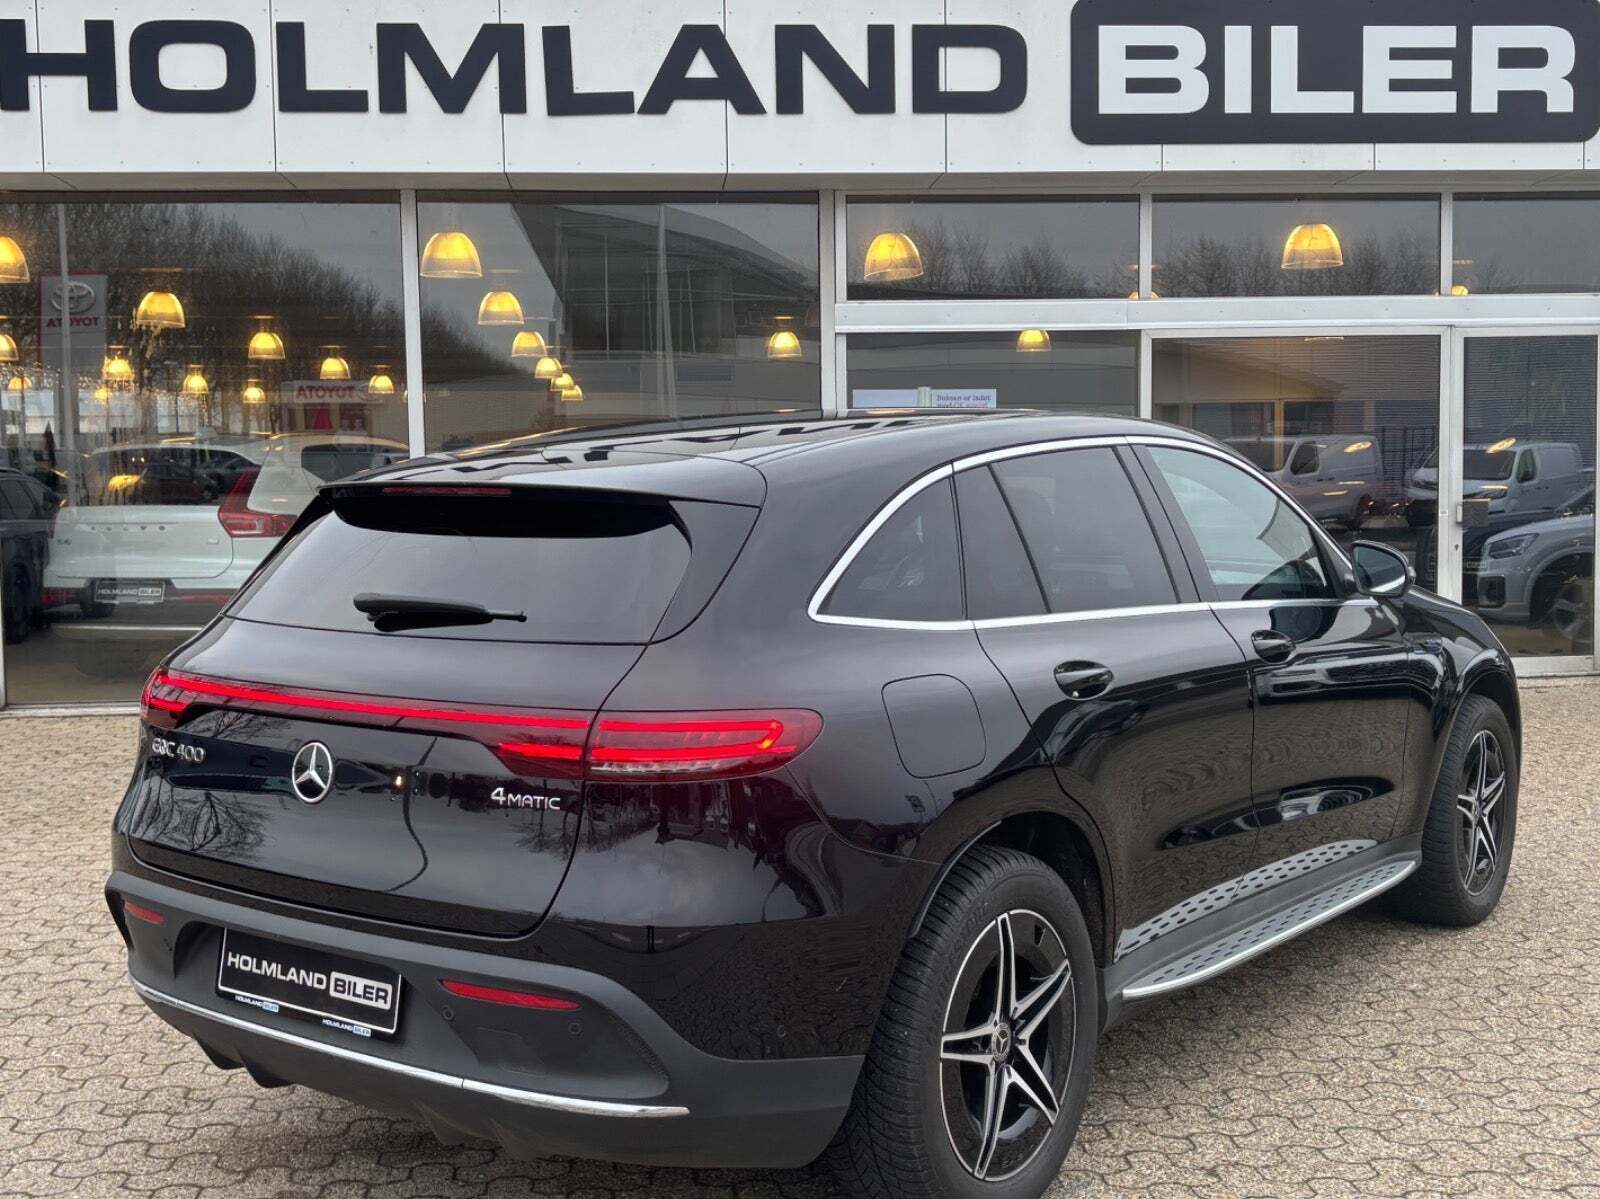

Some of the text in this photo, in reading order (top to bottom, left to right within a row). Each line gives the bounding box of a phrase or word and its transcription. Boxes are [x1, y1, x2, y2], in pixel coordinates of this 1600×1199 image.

[0, 19, 1577, 116] HOLMLAND BILER
[177, 743, 206, 763] 400
[490, 787, 561, 810] 4MATIC
[227, 952, 389, 1004] HOLMLAND BILER
